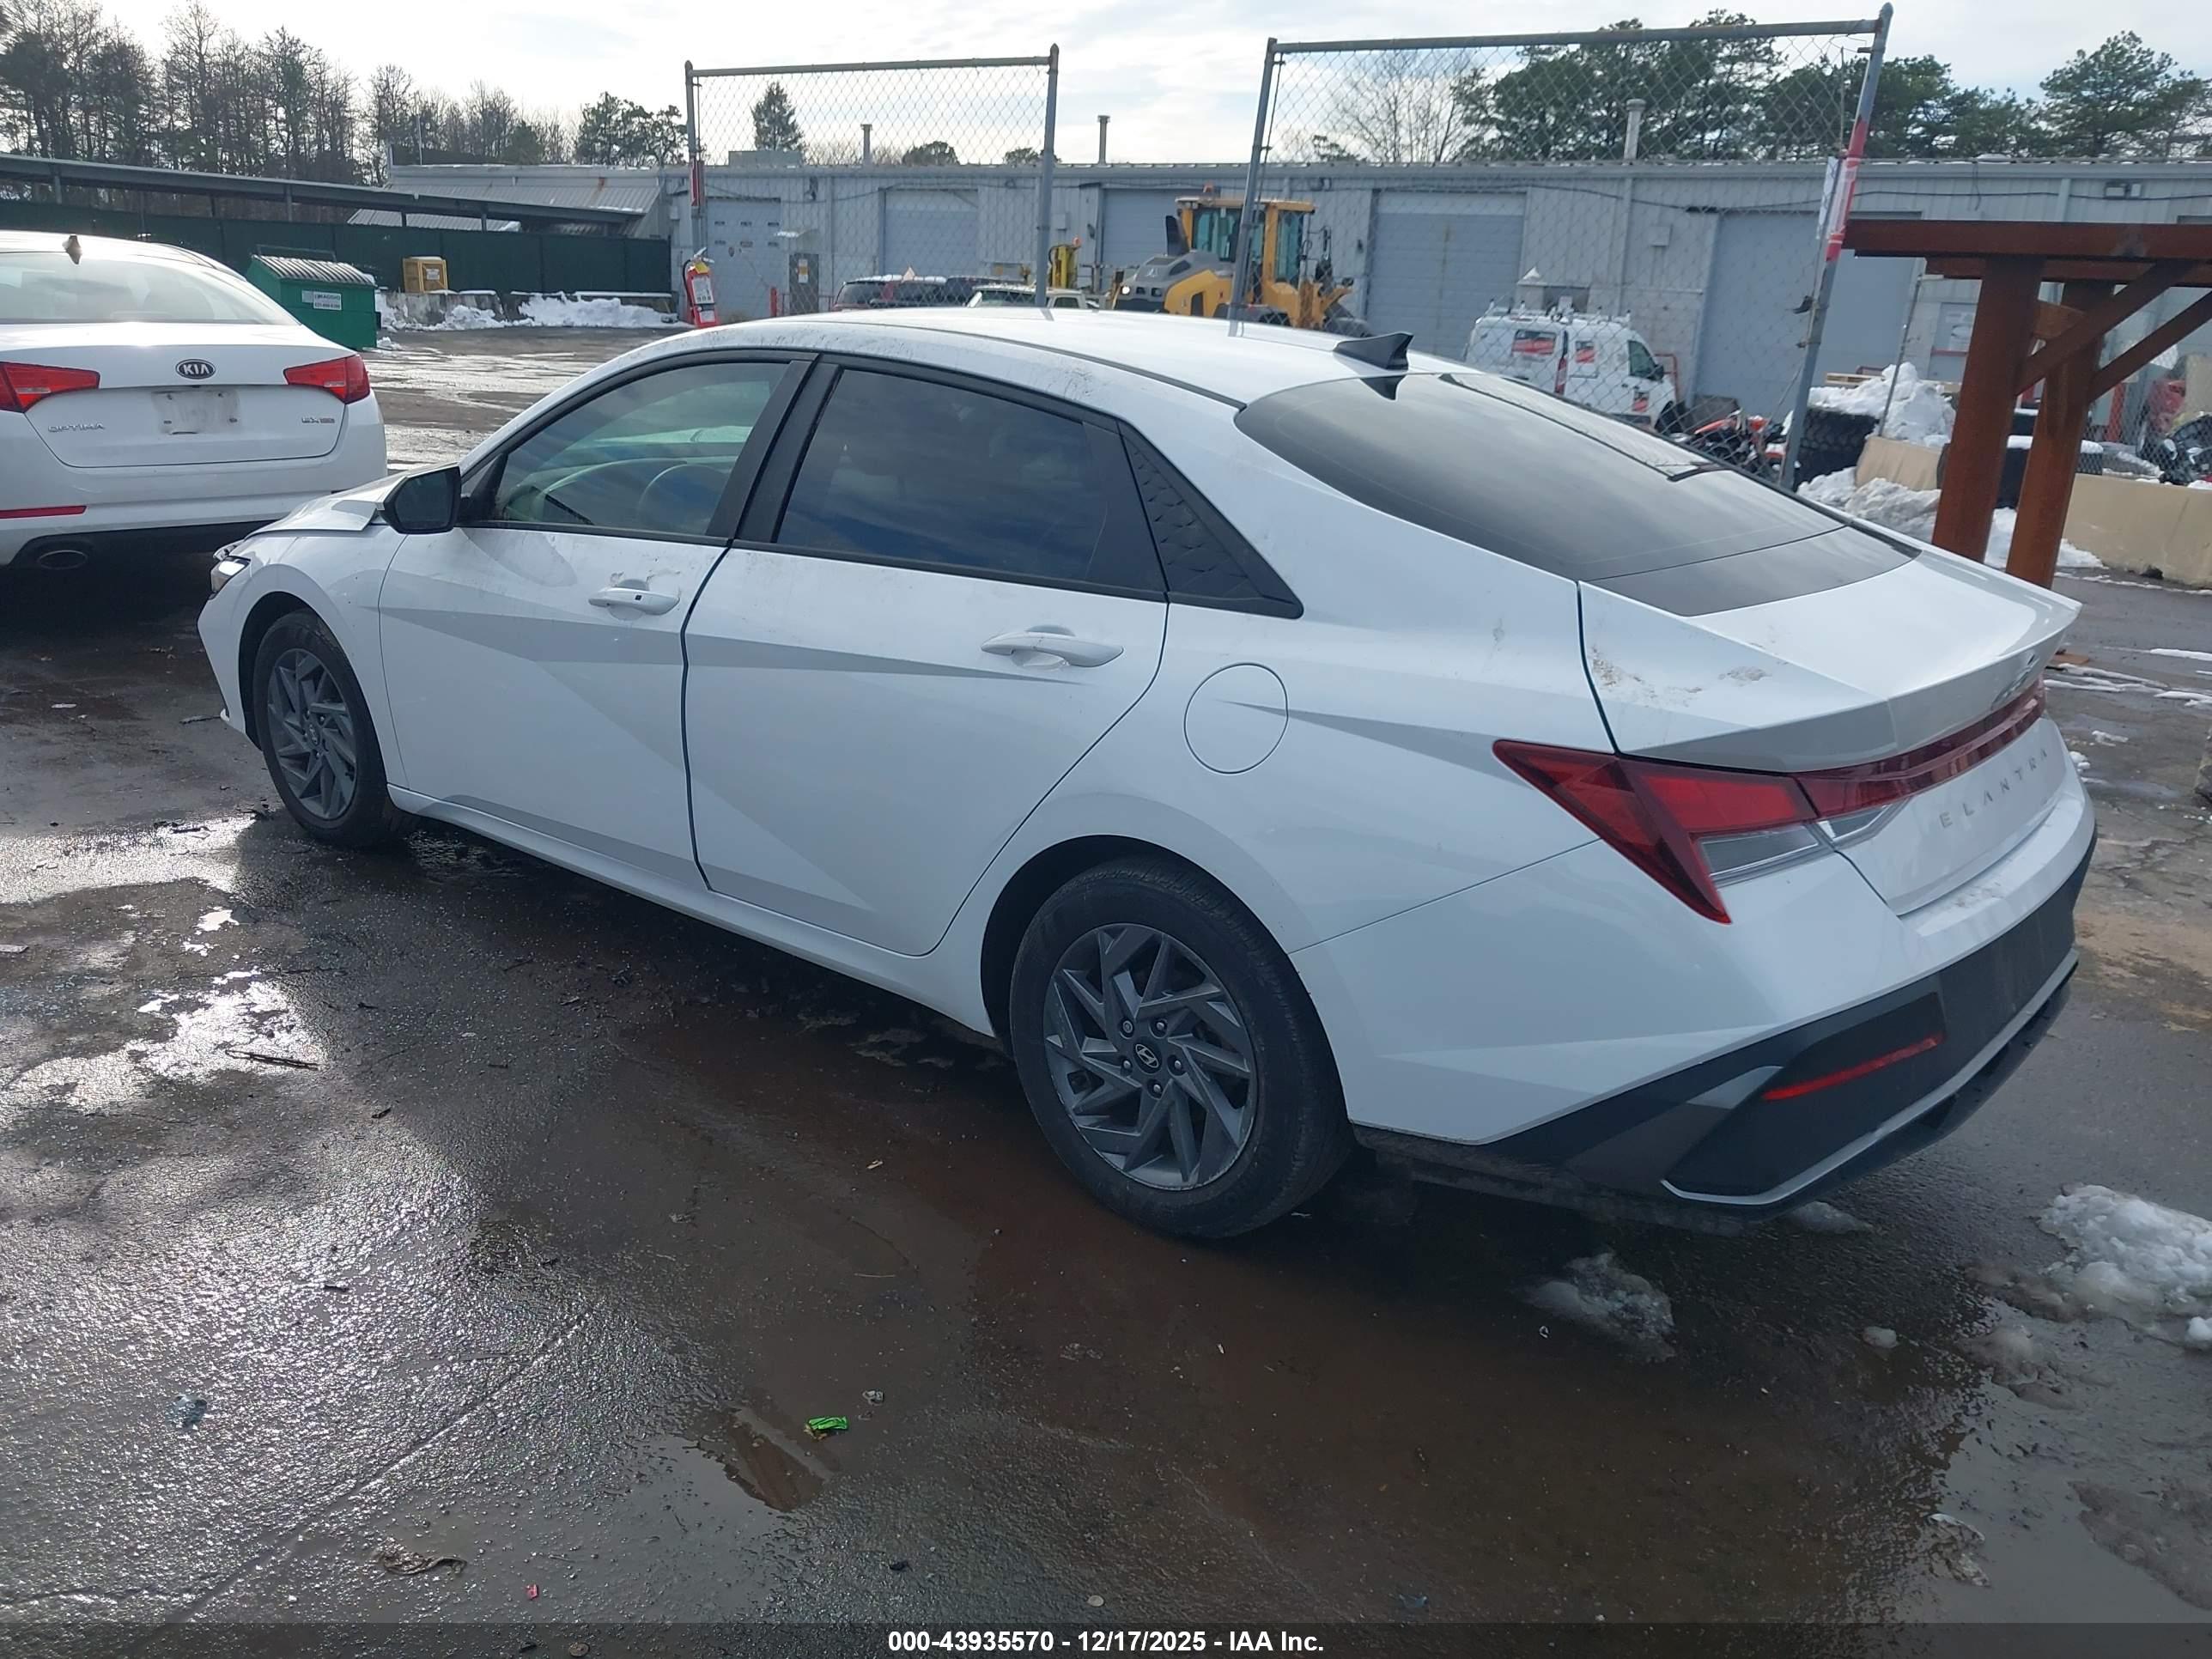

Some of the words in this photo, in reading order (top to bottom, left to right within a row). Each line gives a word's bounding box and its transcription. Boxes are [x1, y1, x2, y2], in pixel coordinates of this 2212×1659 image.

[183, 363, 210, 374] KIA
[48, 423, 104, 433] OPTIMA
[1939, 749, 2048, 829] ELANTRA
